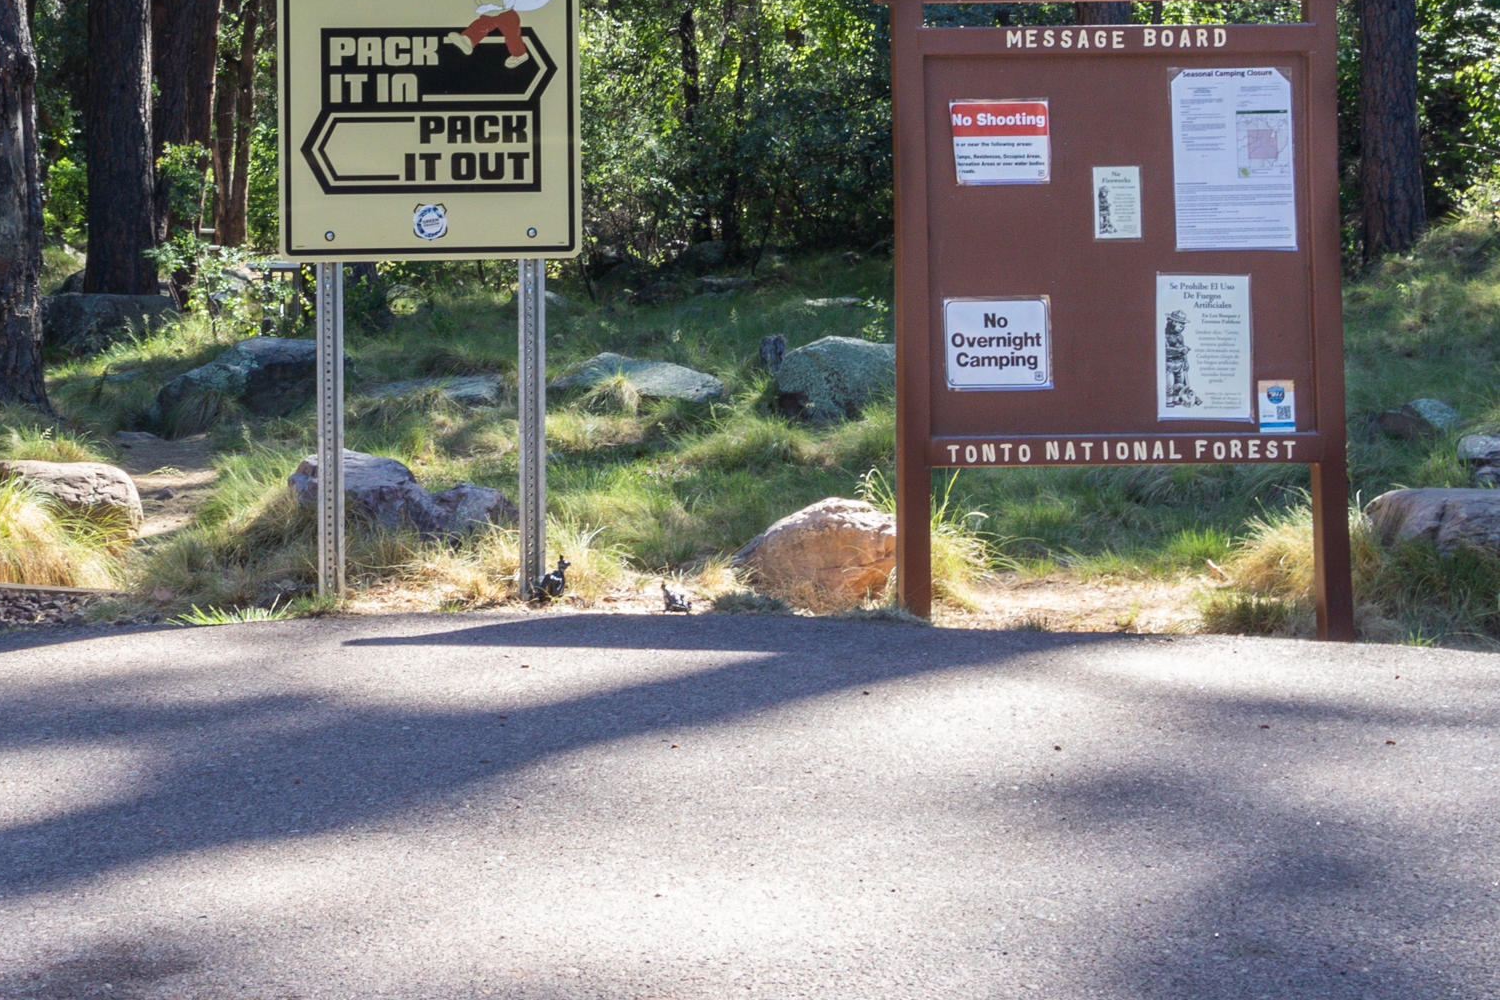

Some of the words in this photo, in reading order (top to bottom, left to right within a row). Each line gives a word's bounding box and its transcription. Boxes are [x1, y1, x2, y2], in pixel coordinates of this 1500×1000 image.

[1006, 29, 1125, 49] MESSAGE
[1143, 28, 1227, 48] BOARD
[329, 36, 439, 67] PACK
[1182, 70, 1213, 78] Seasonal
[1215, 70, 1246, 78] Camping
[329, 73, 368, 103] IT
[376, 73, 418, 103] IN
[952, 113, 972, 126] No
[977, 112, 1045, 127] Shooting
[419, 115, 528, 144] PACK
[404, 153, 442, 182] IT
[450, 152, 530, 181] OUT
[1210, 282, 1218, 290] El
[1194, 301, 1232, 309] Artificiales
[1196, 292, 1221, 302] Fuegos
[984, 312, 1008, 328] No
[951, 332, 1042, 351] Overnight
[956, 352, 1038, 370] Camping
[946, 442, 1031, 463] TONTO
[1045, 440, 1182, 461] NATIONAL
[1194, 439, 1296, 460] FOREST
